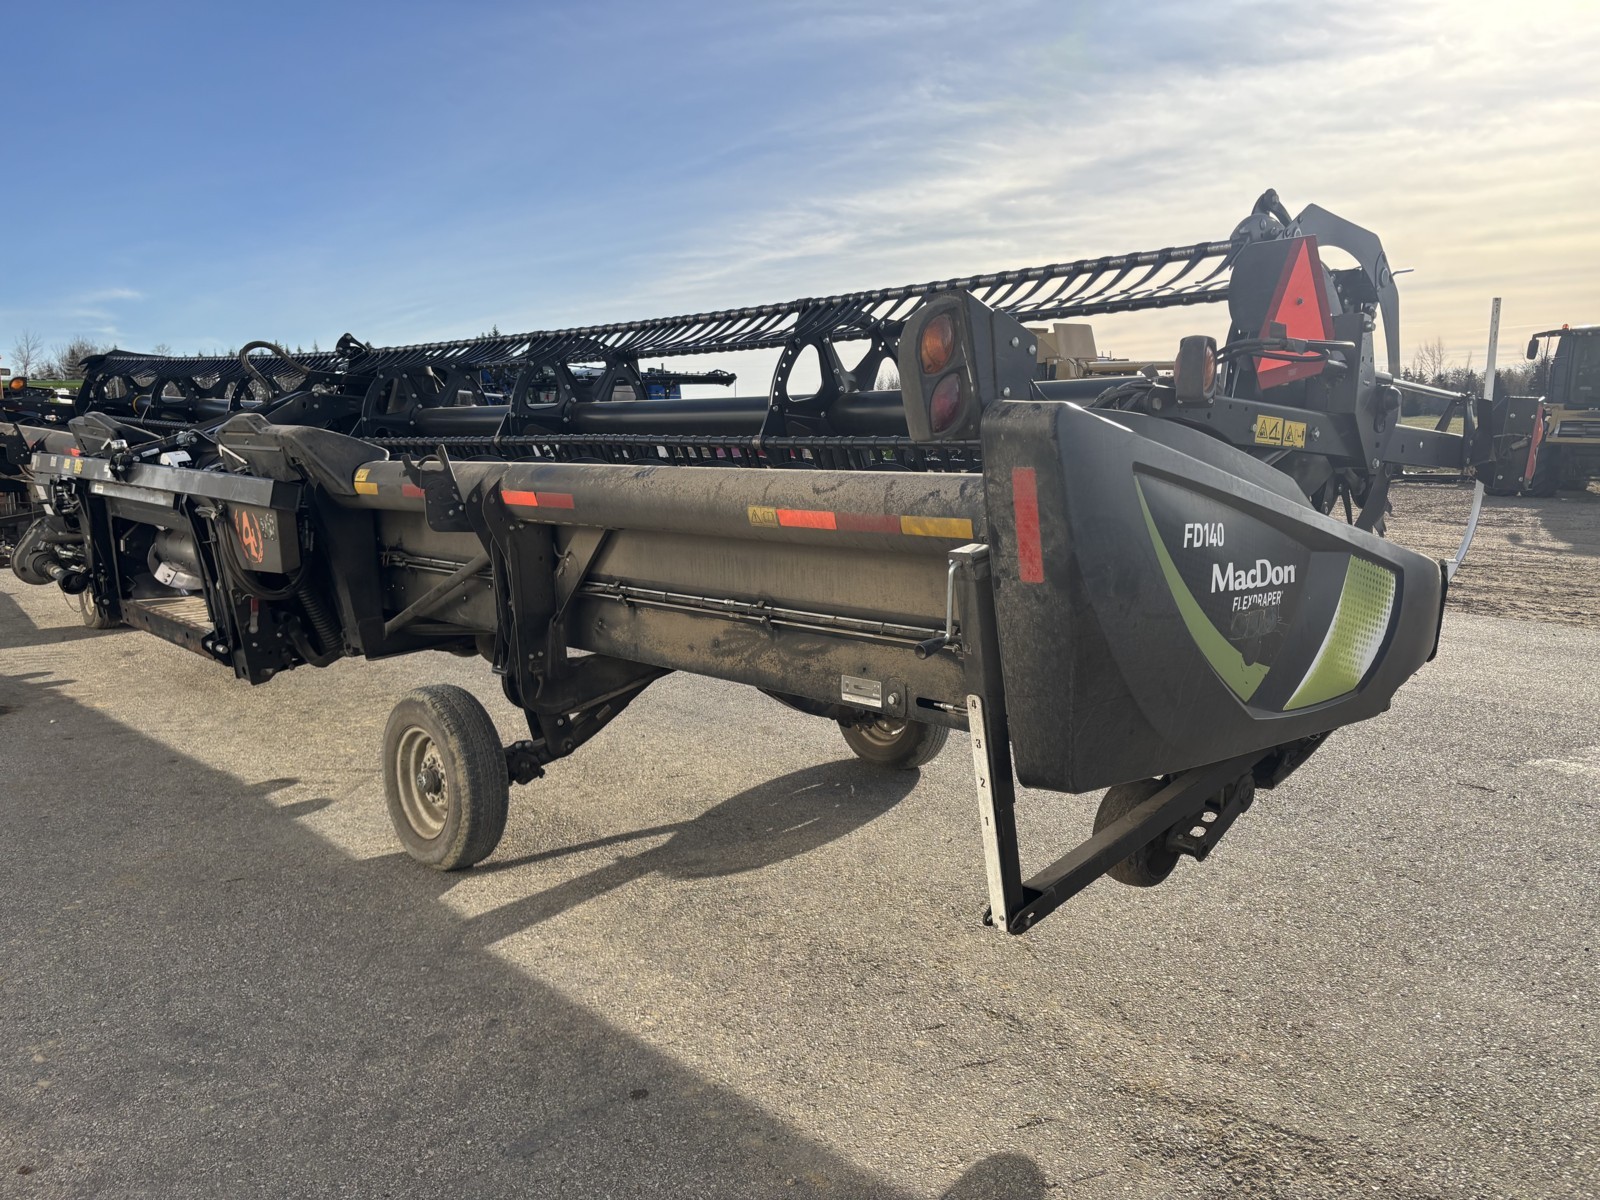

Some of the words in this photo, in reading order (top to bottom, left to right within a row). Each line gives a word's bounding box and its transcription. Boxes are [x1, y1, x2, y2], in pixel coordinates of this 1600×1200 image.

[1183, 523, 1225, 548] FD140
[1211, 559, 1295, 593] MacDon
[971, 700, 977, 710] 4
[975, 739, 981, 749] 3
[980, 777, 986, 788] 2
